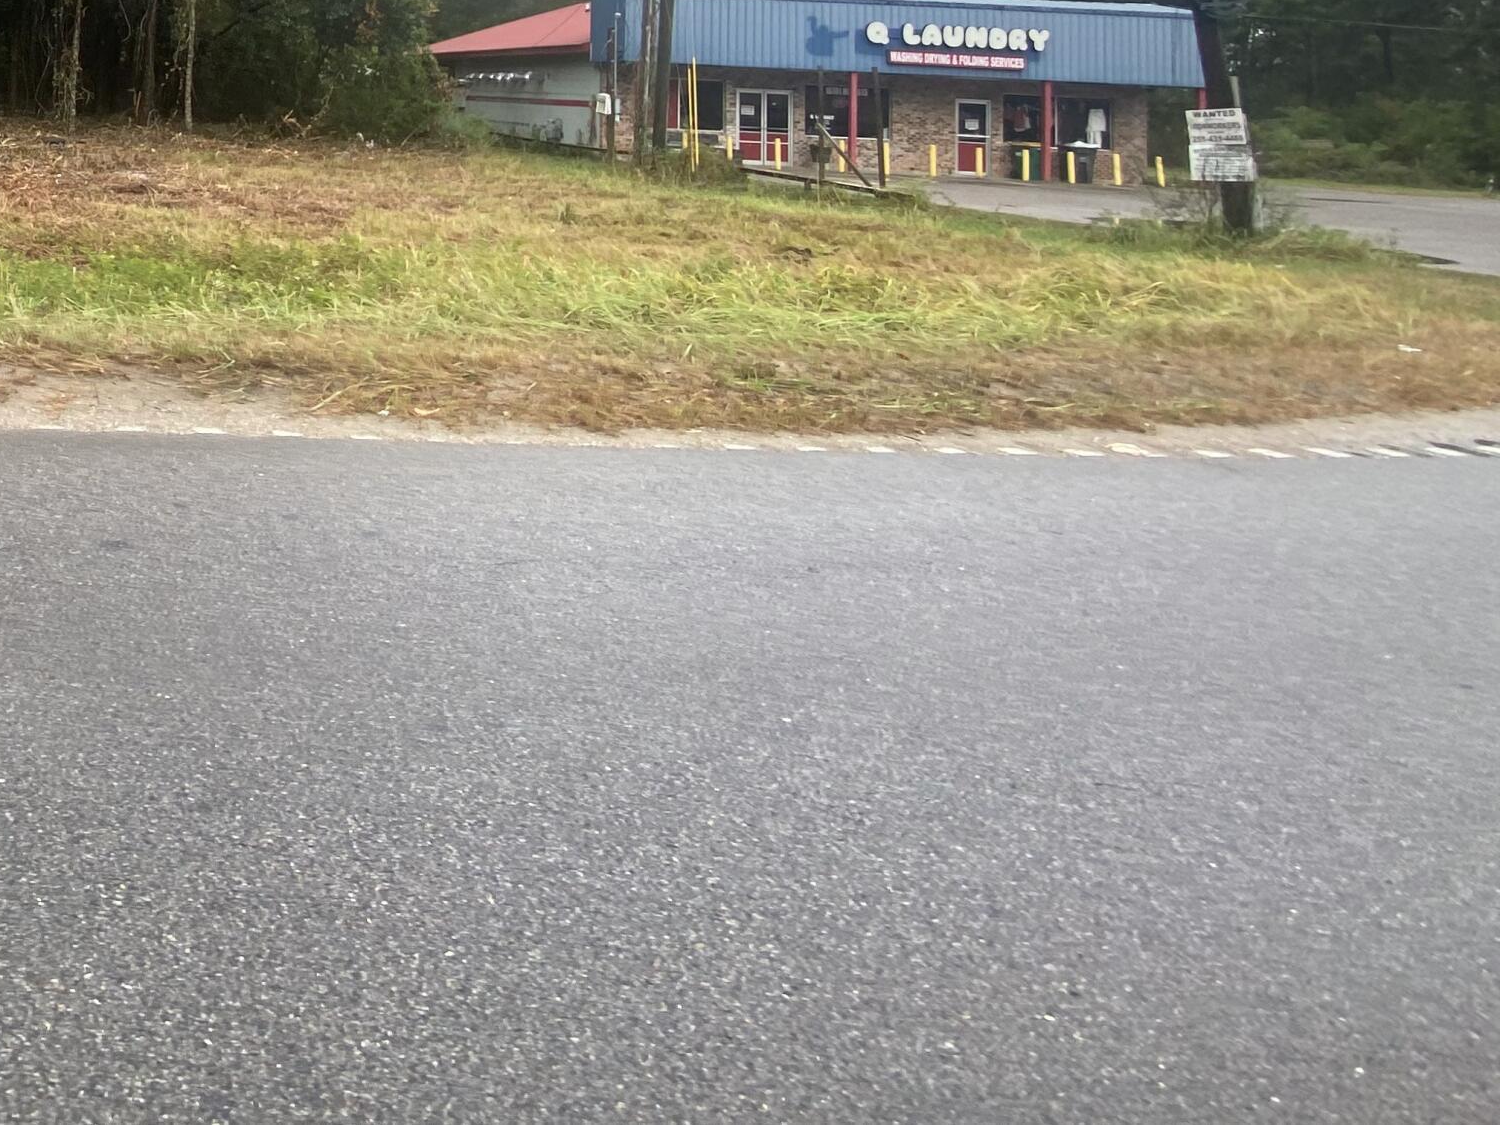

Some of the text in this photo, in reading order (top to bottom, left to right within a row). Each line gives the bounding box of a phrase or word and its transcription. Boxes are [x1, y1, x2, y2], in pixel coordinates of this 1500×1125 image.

[866, 21, 1051, 52] Q LAUNDRY
[890, 51, 1025, 69] WASHING DRYING & FOLDING SERVICES
